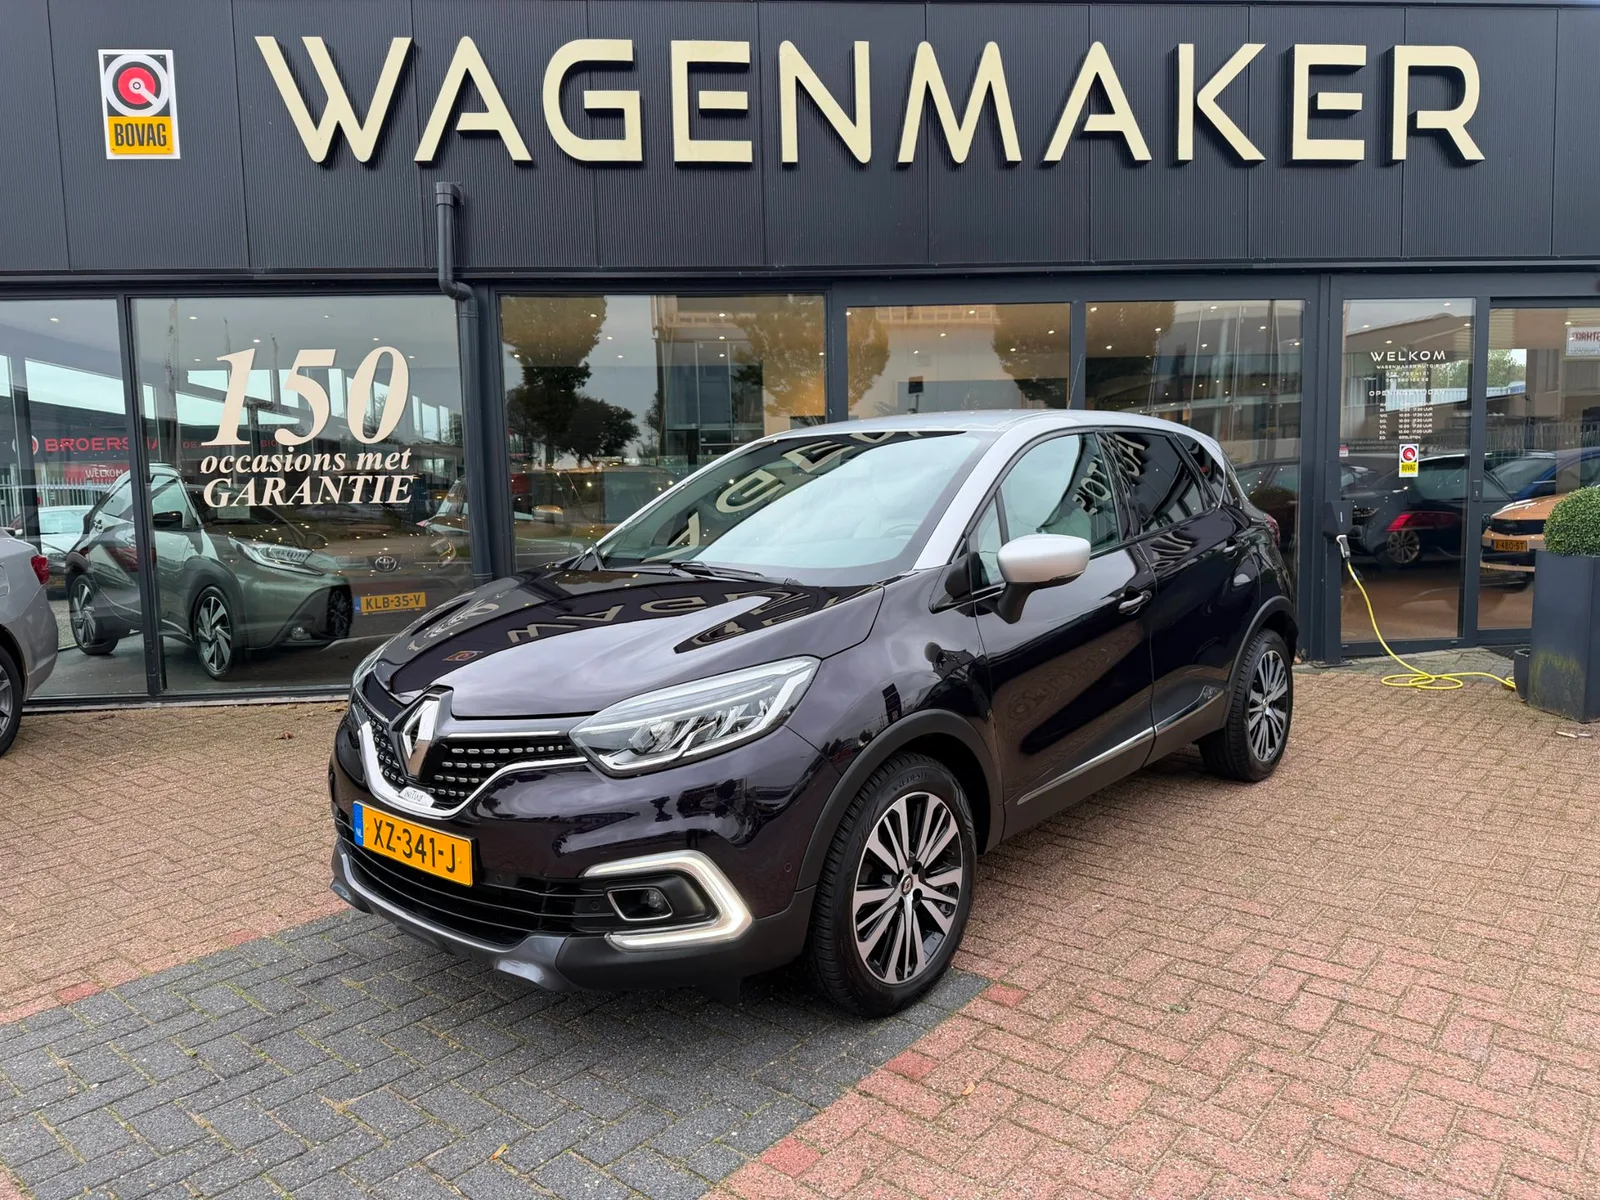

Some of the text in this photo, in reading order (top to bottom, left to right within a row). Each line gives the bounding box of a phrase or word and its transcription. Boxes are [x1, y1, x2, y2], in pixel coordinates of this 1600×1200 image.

[255, 36, 1485, 164] WAGENMAKER
[114, 122, 168, 147] BOVAG
[1370, 350, 1446, 361] WELKOM
[201, 346, 409, 446] 150
[200, 446, 412, 474] occasions met
[1401, 463, 1416, 472] BOVAG
[203, 475, 414, 508] GARANTIE
[366, 594, 421, 610] KLB-35-V
[373, 817, 457, 873] XZ-341-J
